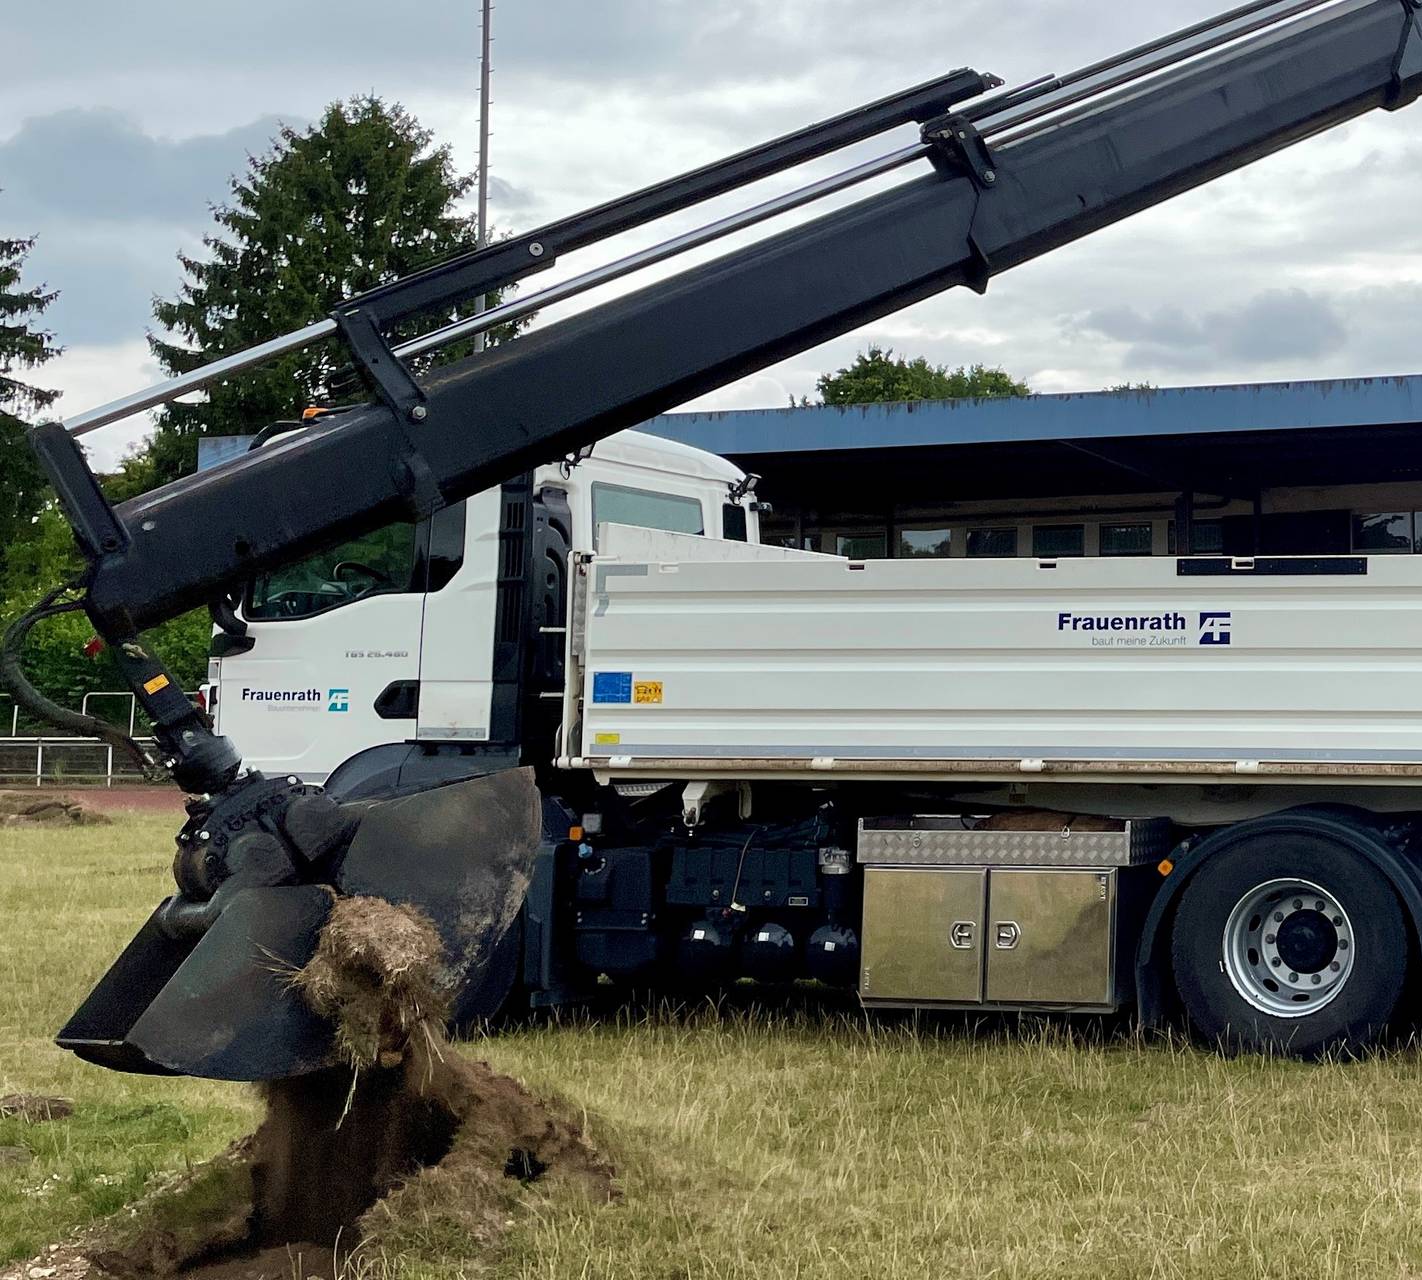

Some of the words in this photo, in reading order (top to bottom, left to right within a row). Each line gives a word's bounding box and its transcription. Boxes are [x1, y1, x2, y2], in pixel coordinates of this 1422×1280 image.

[1058, 612, 1186, 630] Frauenrath
[1091, 636, 1114, 646] baut
[1117, 636, 1147, 646] meine
[1149, 635, 1187, 646] Zukunft
[242, 688, 321, 701] Frauenrath
